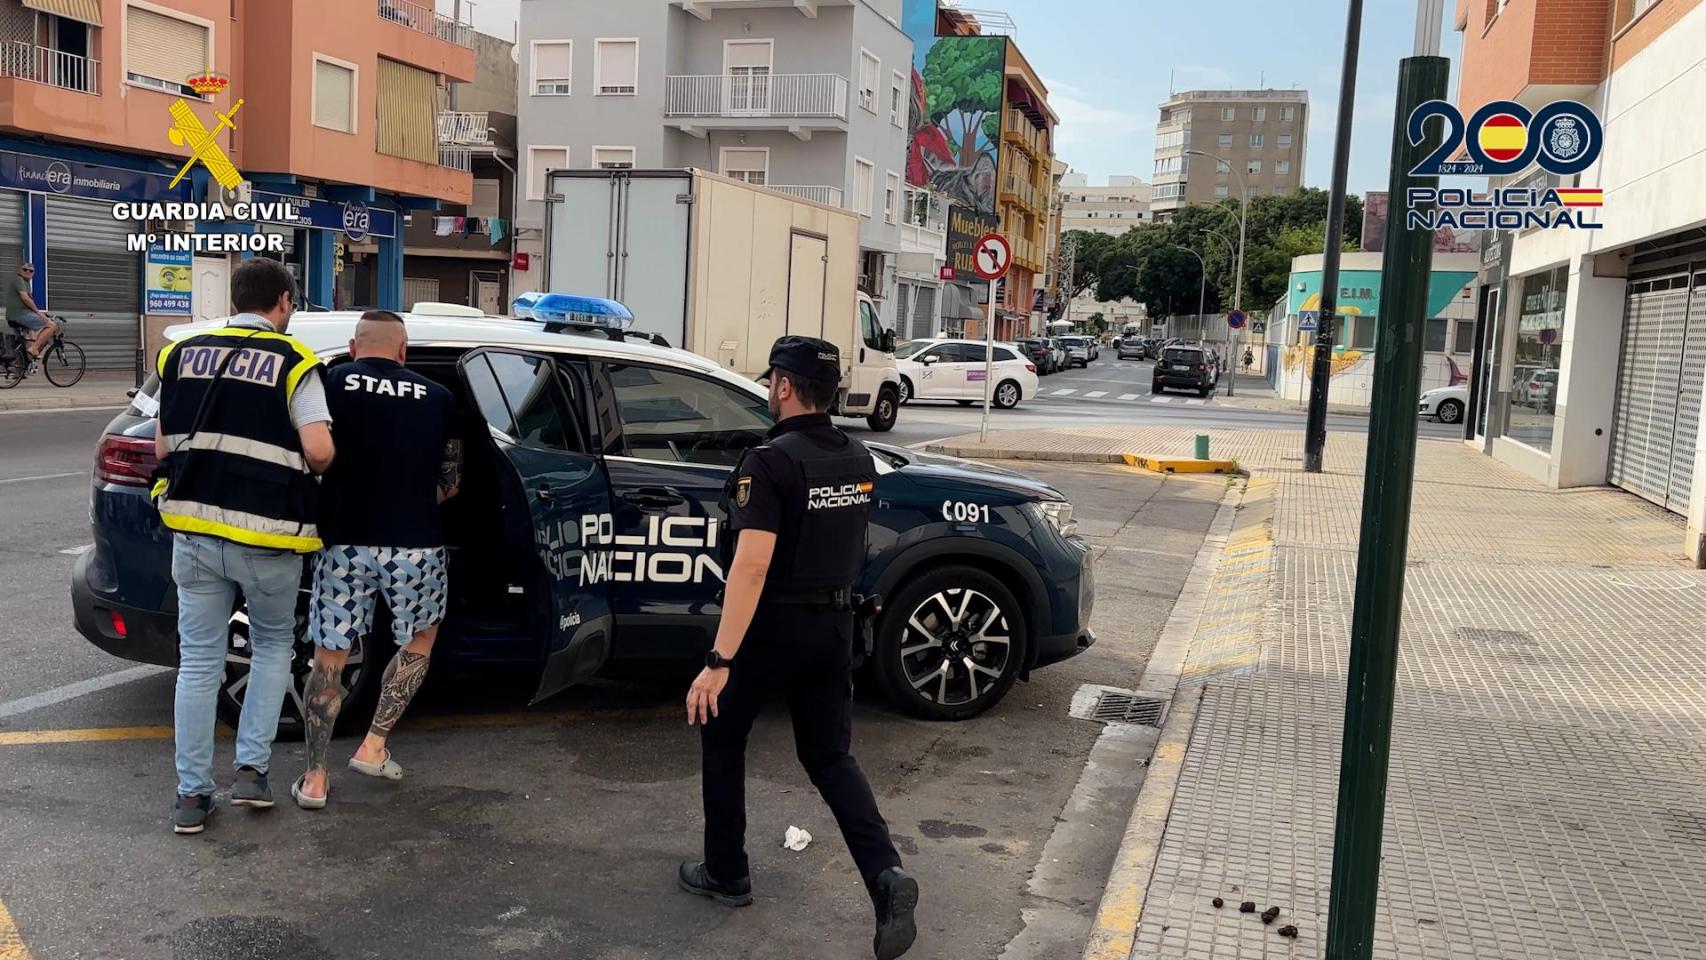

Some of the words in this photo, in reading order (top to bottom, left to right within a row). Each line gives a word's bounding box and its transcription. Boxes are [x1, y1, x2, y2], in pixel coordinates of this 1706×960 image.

[73, 175, 121, 191] inmobiliaria
[954, 252, 975, 273] RUB
[149, 300, 162, 308] 960
[163, 300, 176, 308] 499
[177, 300, 189, 308] 438
[179, 348, 277, 384] POLCIA
[344, 373, 428, 400] STAFF
[808, 493, 871, 510] NACIONAL
[953, 501, 990, 523] 091
